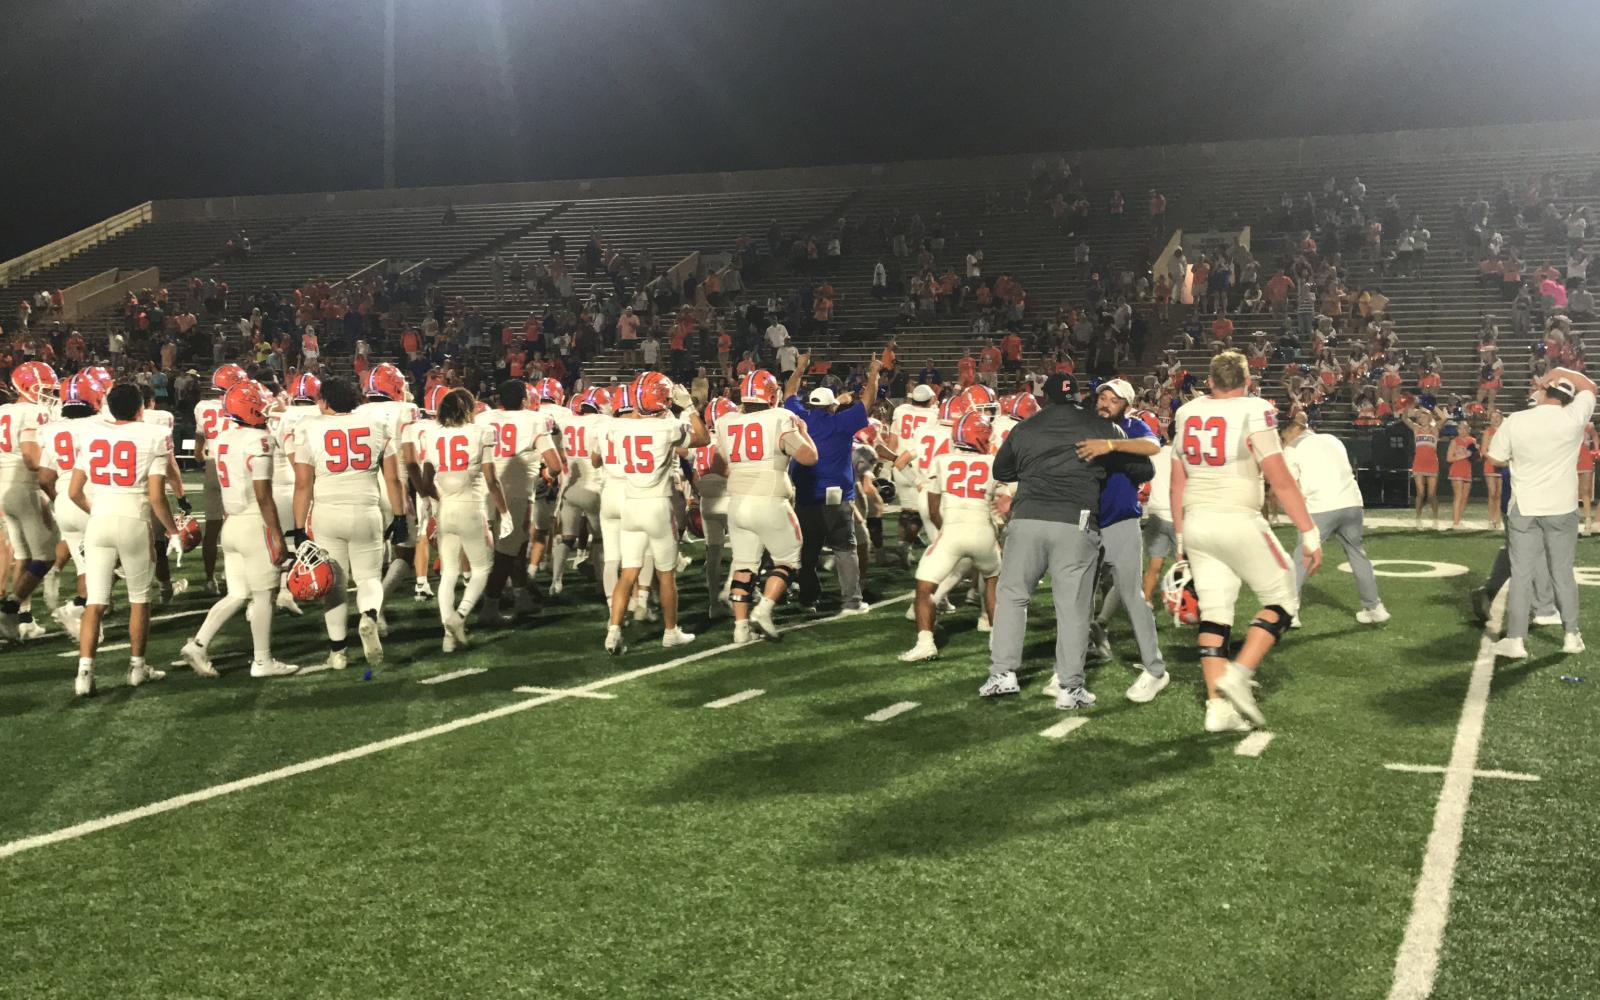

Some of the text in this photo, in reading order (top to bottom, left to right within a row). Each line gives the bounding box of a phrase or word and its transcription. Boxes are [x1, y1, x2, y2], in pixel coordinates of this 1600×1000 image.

[54, 431, 80, 470] 9
[324, 427, 372, 473] 95
[436, 435, 469, 472] 16
[564, 426, 588, 457] 31
[623, 436, 655, 474] 15
[728, 422, 764, 462] 78
[1184, 416, 1227, 466] 63
[89, 439, 137, 486] 29
[218, 444, 230, 488] 5
[947, 461, 989, 499] 22
